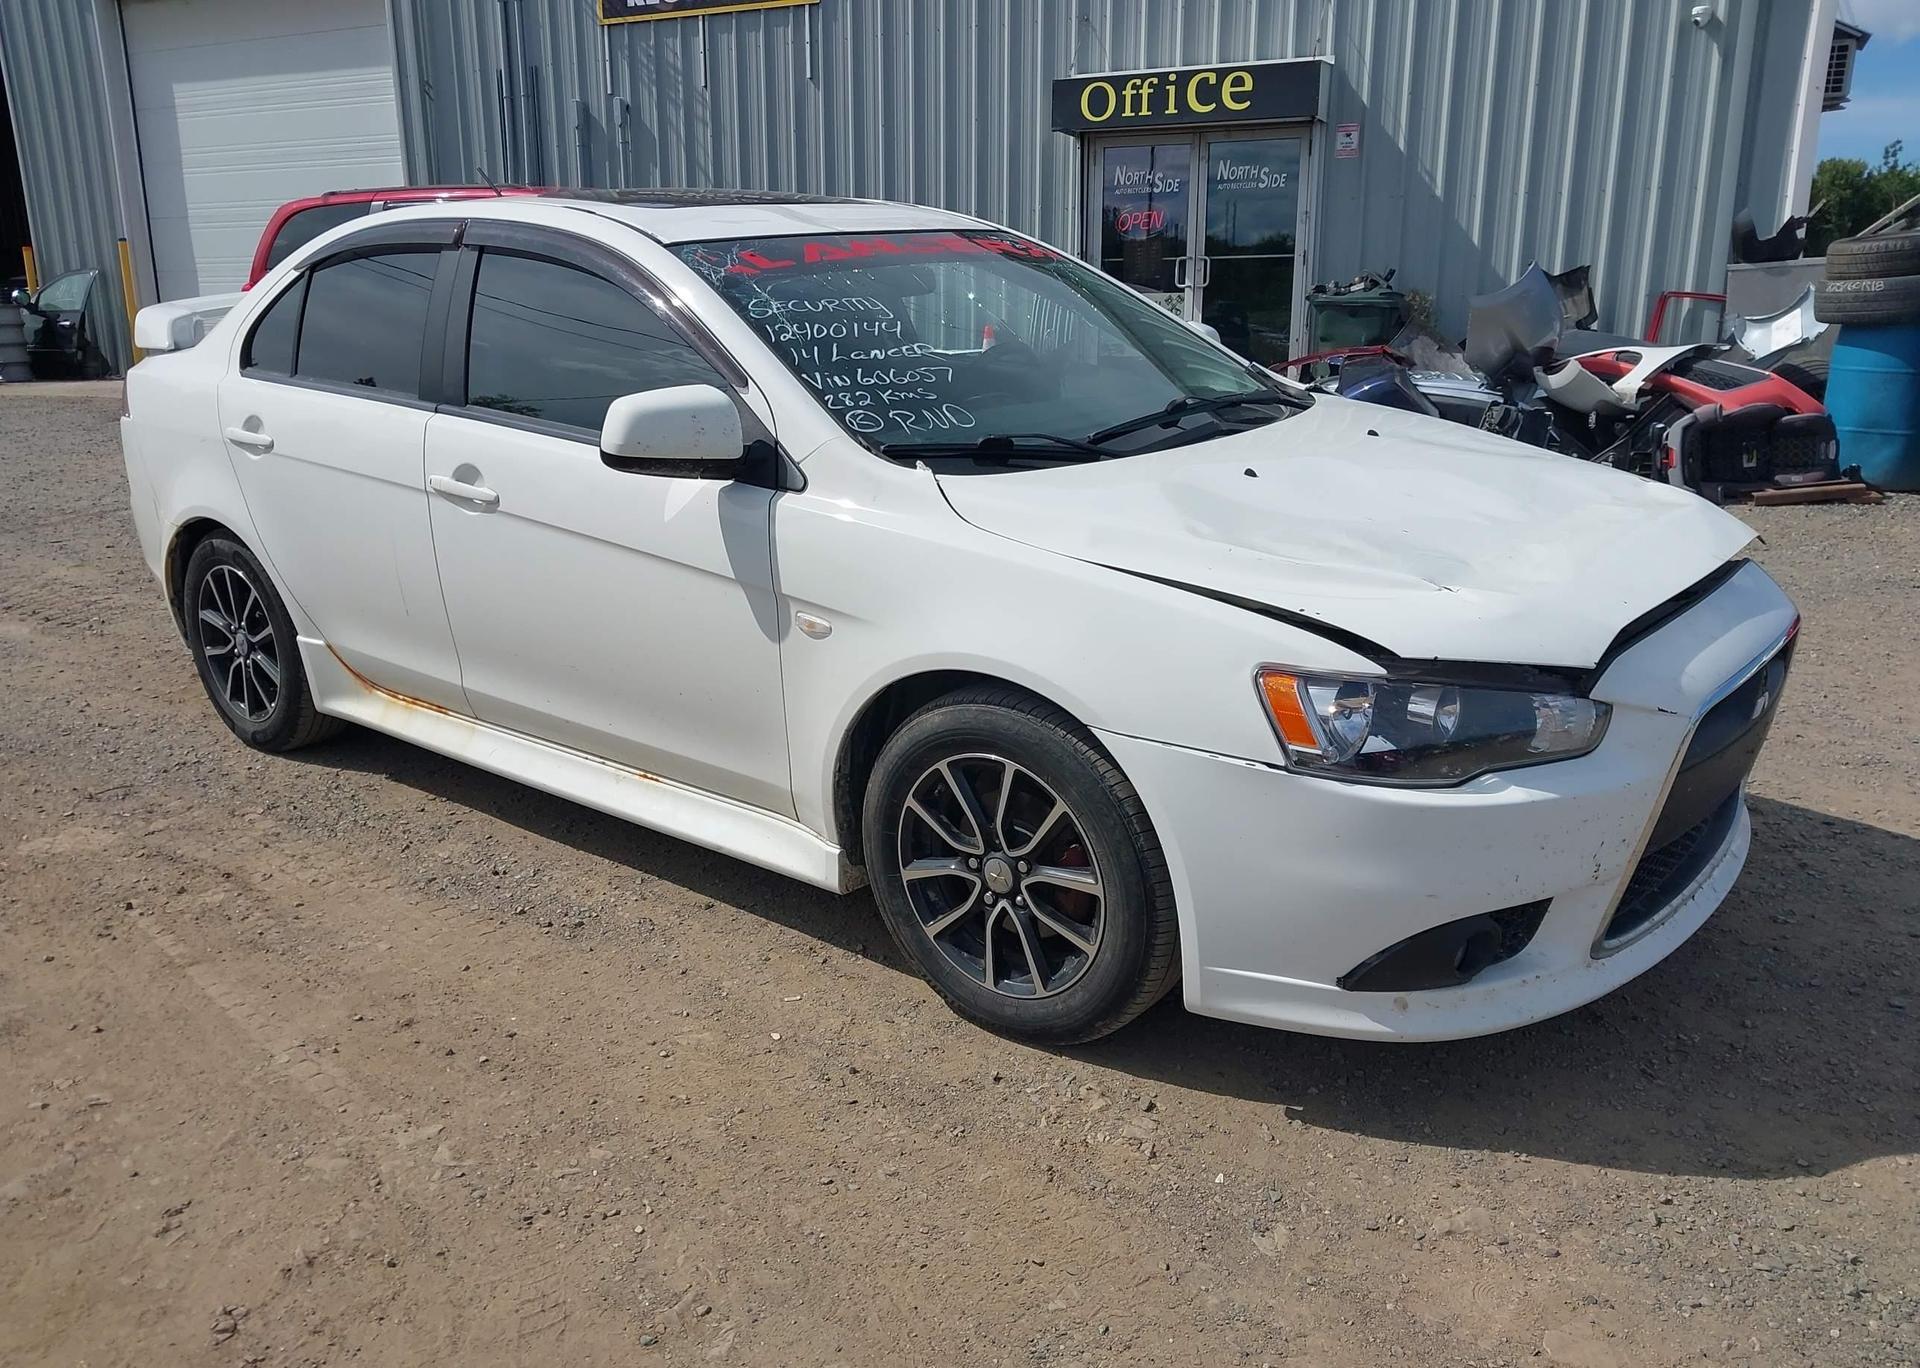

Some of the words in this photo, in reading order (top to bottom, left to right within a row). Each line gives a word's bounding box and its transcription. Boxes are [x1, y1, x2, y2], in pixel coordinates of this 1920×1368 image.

[1080, 70, 1254, 122] Office
[1114, 165, 1153, 186] NORTH
[1153, 172, 1180, 193] SIDE
[1217, 159, 1259, 180] NORTH
[1258, 167, 1287, 188] SIDE
[1118, 210, 1165, 232] OPEN
[791, 346, 819, 366] 14
[856, 367, 953, 385] 606057
[824, 391, 875, 409] 282
